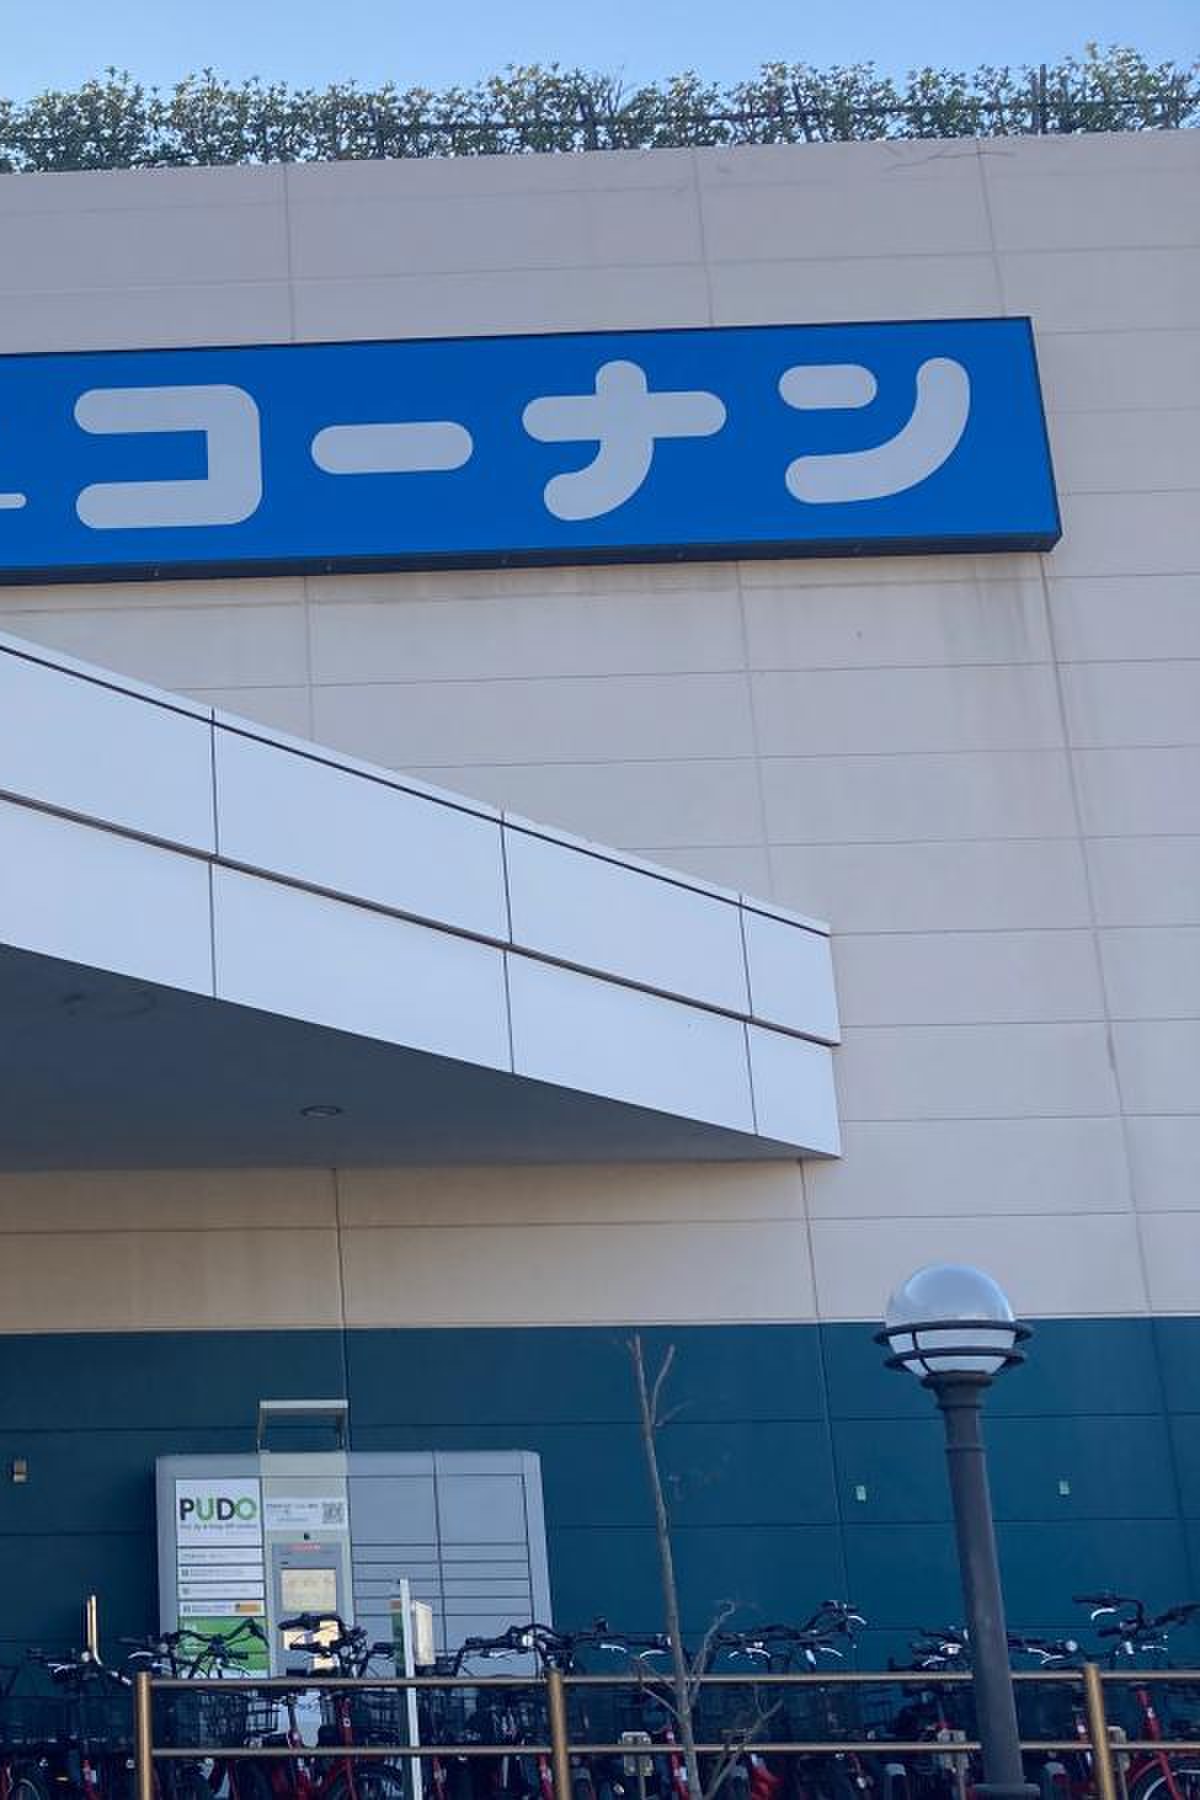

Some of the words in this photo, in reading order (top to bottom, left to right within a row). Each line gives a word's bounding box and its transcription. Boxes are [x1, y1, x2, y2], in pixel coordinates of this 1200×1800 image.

[74, 357, 970, 528] コーナン
[179, 1497, 257, 1521] PUDO
